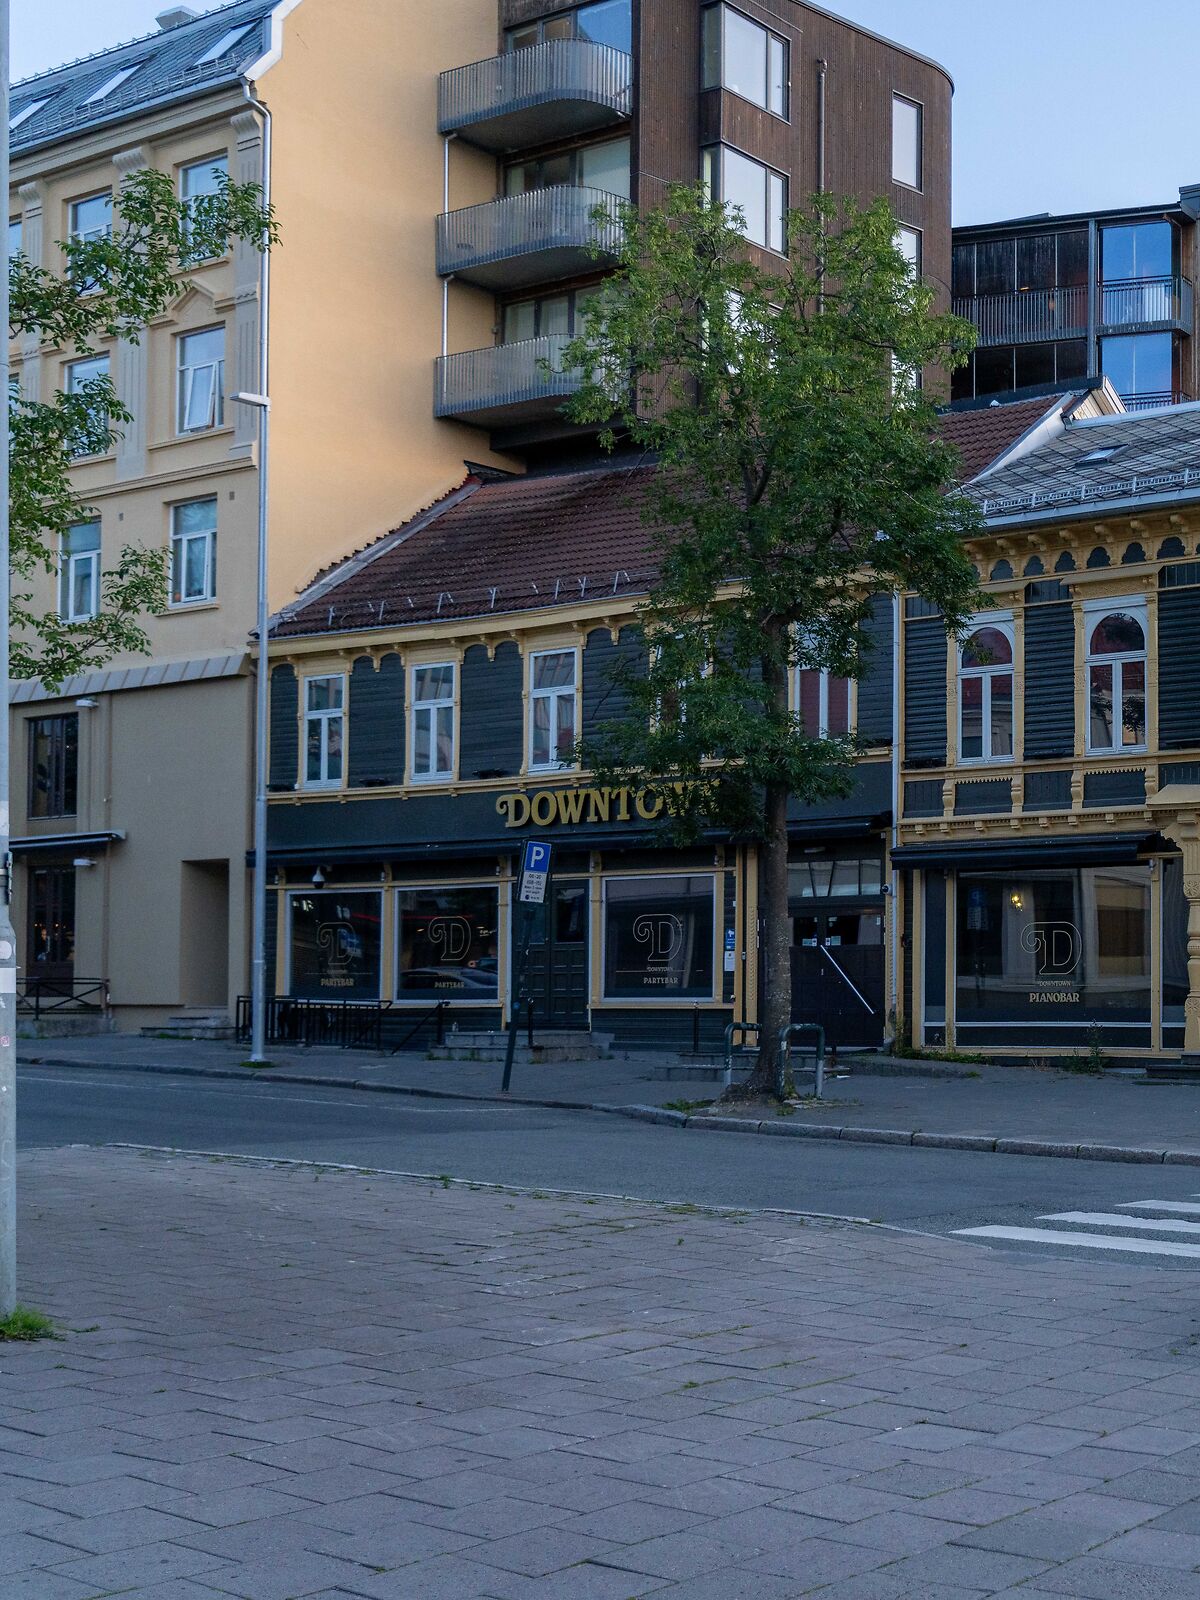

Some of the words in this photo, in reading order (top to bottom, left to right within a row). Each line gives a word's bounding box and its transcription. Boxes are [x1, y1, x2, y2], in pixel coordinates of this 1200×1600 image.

[530, 846, 545, 868] P
[1039, 980, 1072, 988] DOWNTOWN
[1029, 992, 1080, 1003] PIANOBAR
